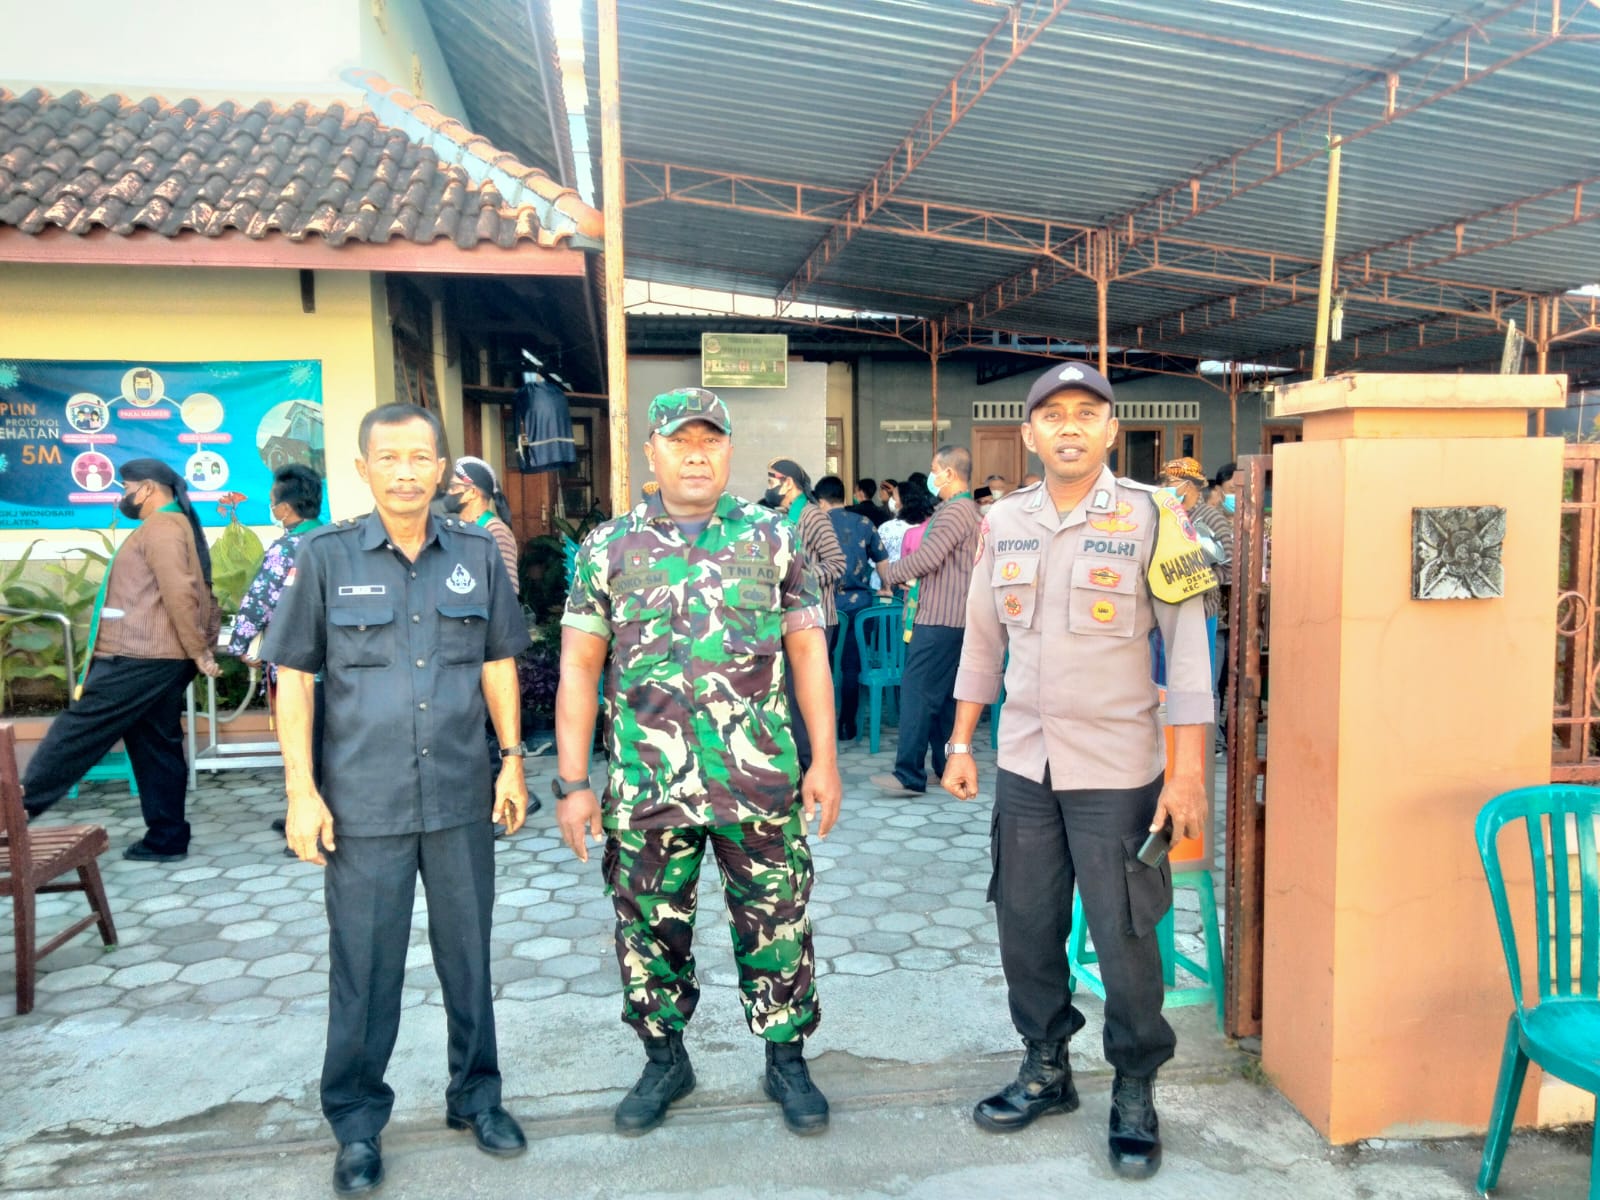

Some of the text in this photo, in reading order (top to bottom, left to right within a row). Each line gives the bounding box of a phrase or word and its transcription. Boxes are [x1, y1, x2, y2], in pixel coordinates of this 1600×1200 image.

[5, 418, 59, 427] PROTOKOL
[22, 445, 62, 465] 5M
[21, 509, 74, 517] WONOSARI
[997, 539, 1039, 552] RIYONO
[1084, 540, 1135, 557] POLRI
[727, 566, 774, 579] TNI AD
